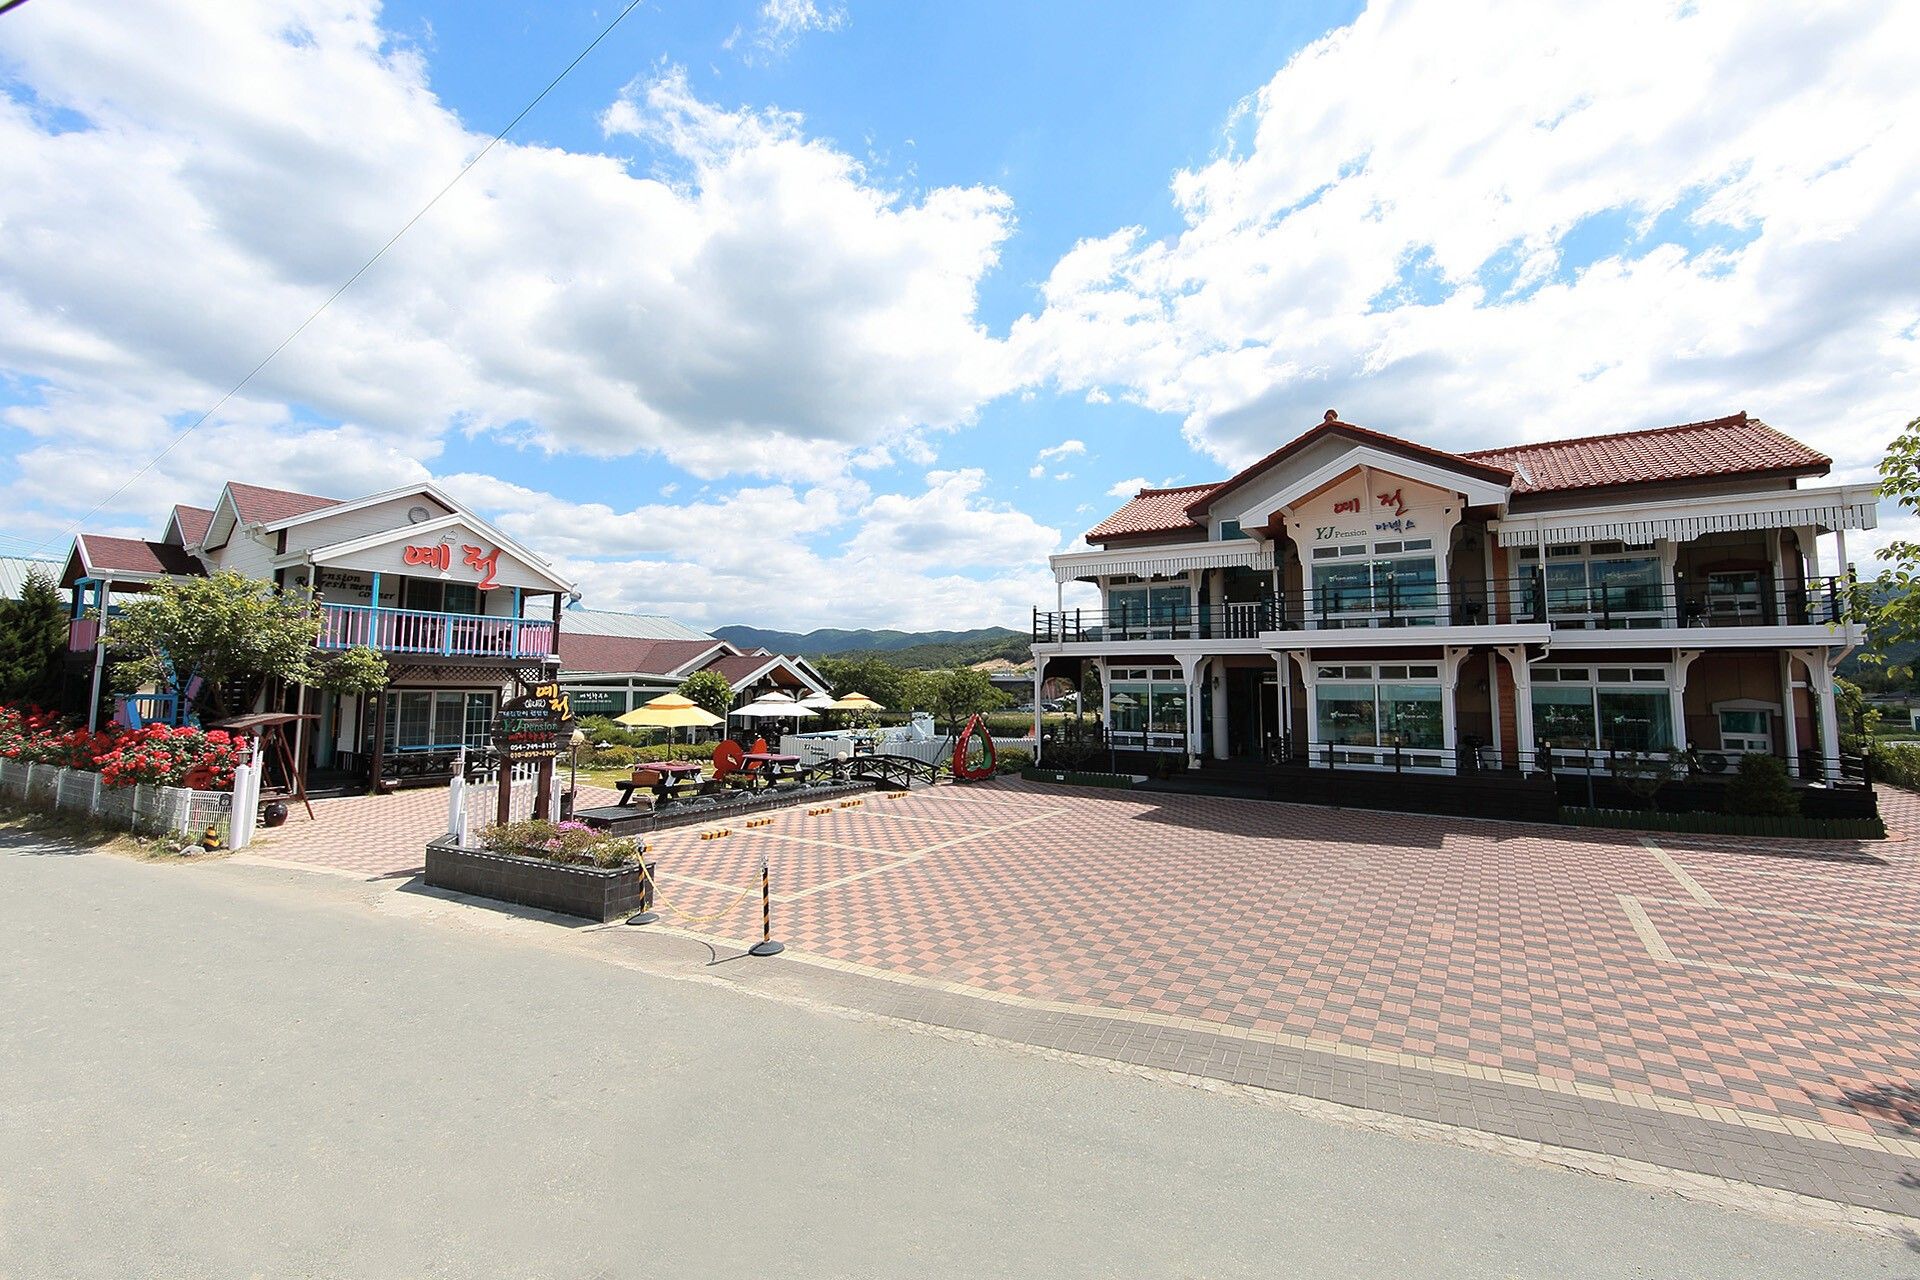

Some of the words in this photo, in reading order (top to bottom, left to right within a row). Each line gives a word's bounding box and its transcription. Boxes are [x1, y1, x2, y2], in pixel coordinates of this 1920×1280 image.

[1333, 488, 1409, 517] 예전
[1315, 526, 1335, 541] YJ
[1335, 529, 1368, 539] Pension
[403, 543, 502, 591] 예전
[358, 590, 396, 600] coner
[503, 719, 523, 732] YJ
